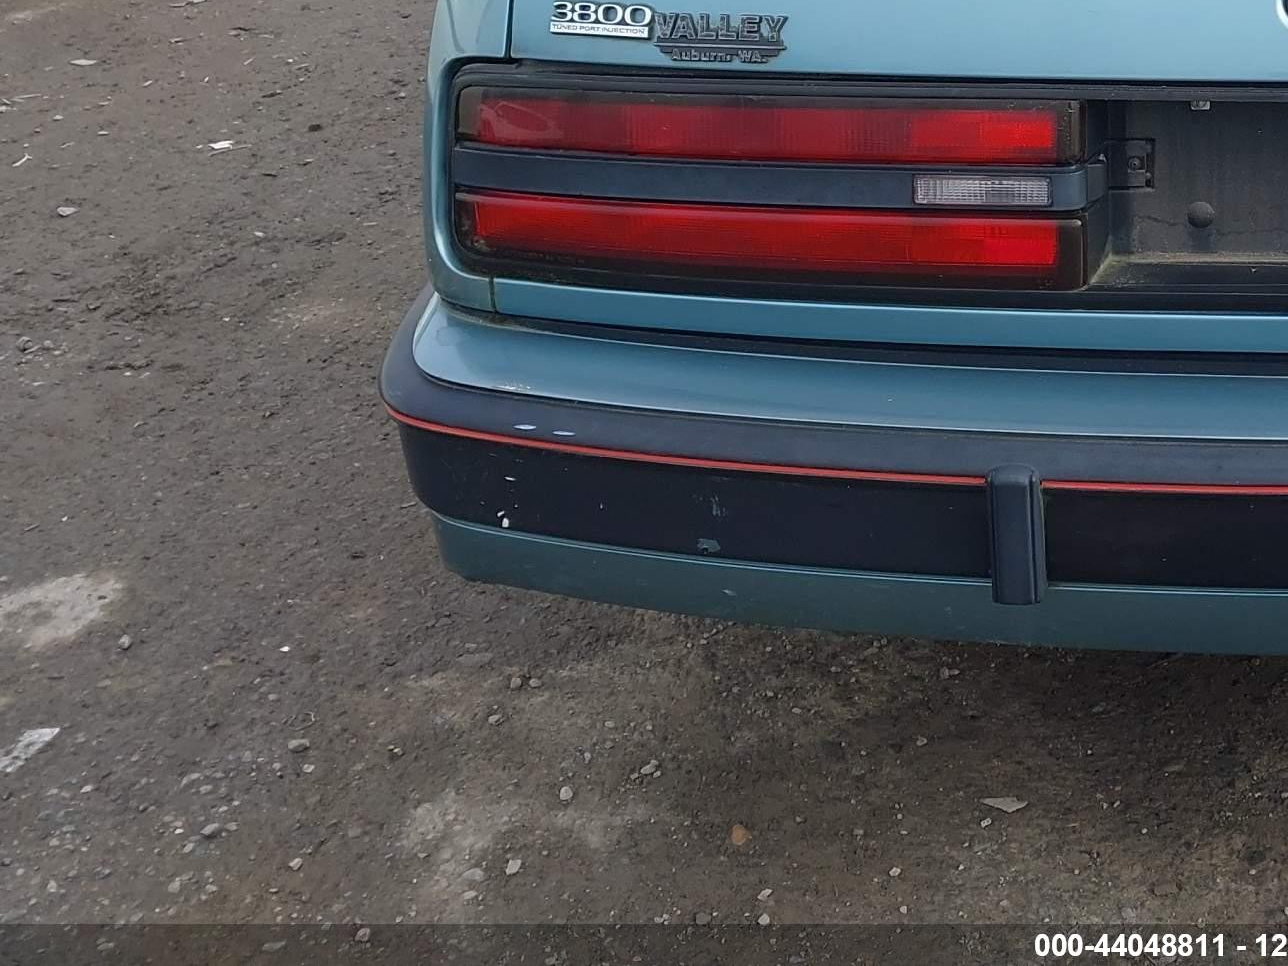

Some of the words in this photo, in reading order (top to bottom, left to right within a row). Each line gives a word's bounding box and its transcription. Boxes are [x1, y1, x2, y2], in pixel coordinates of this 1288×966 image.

[551, 1, 652, 26] 3800
[552, 23, 578, 31] TUNED
[601, 26, 646, 35] INJECTION
[655, 13, 788, 42] VALLEY
